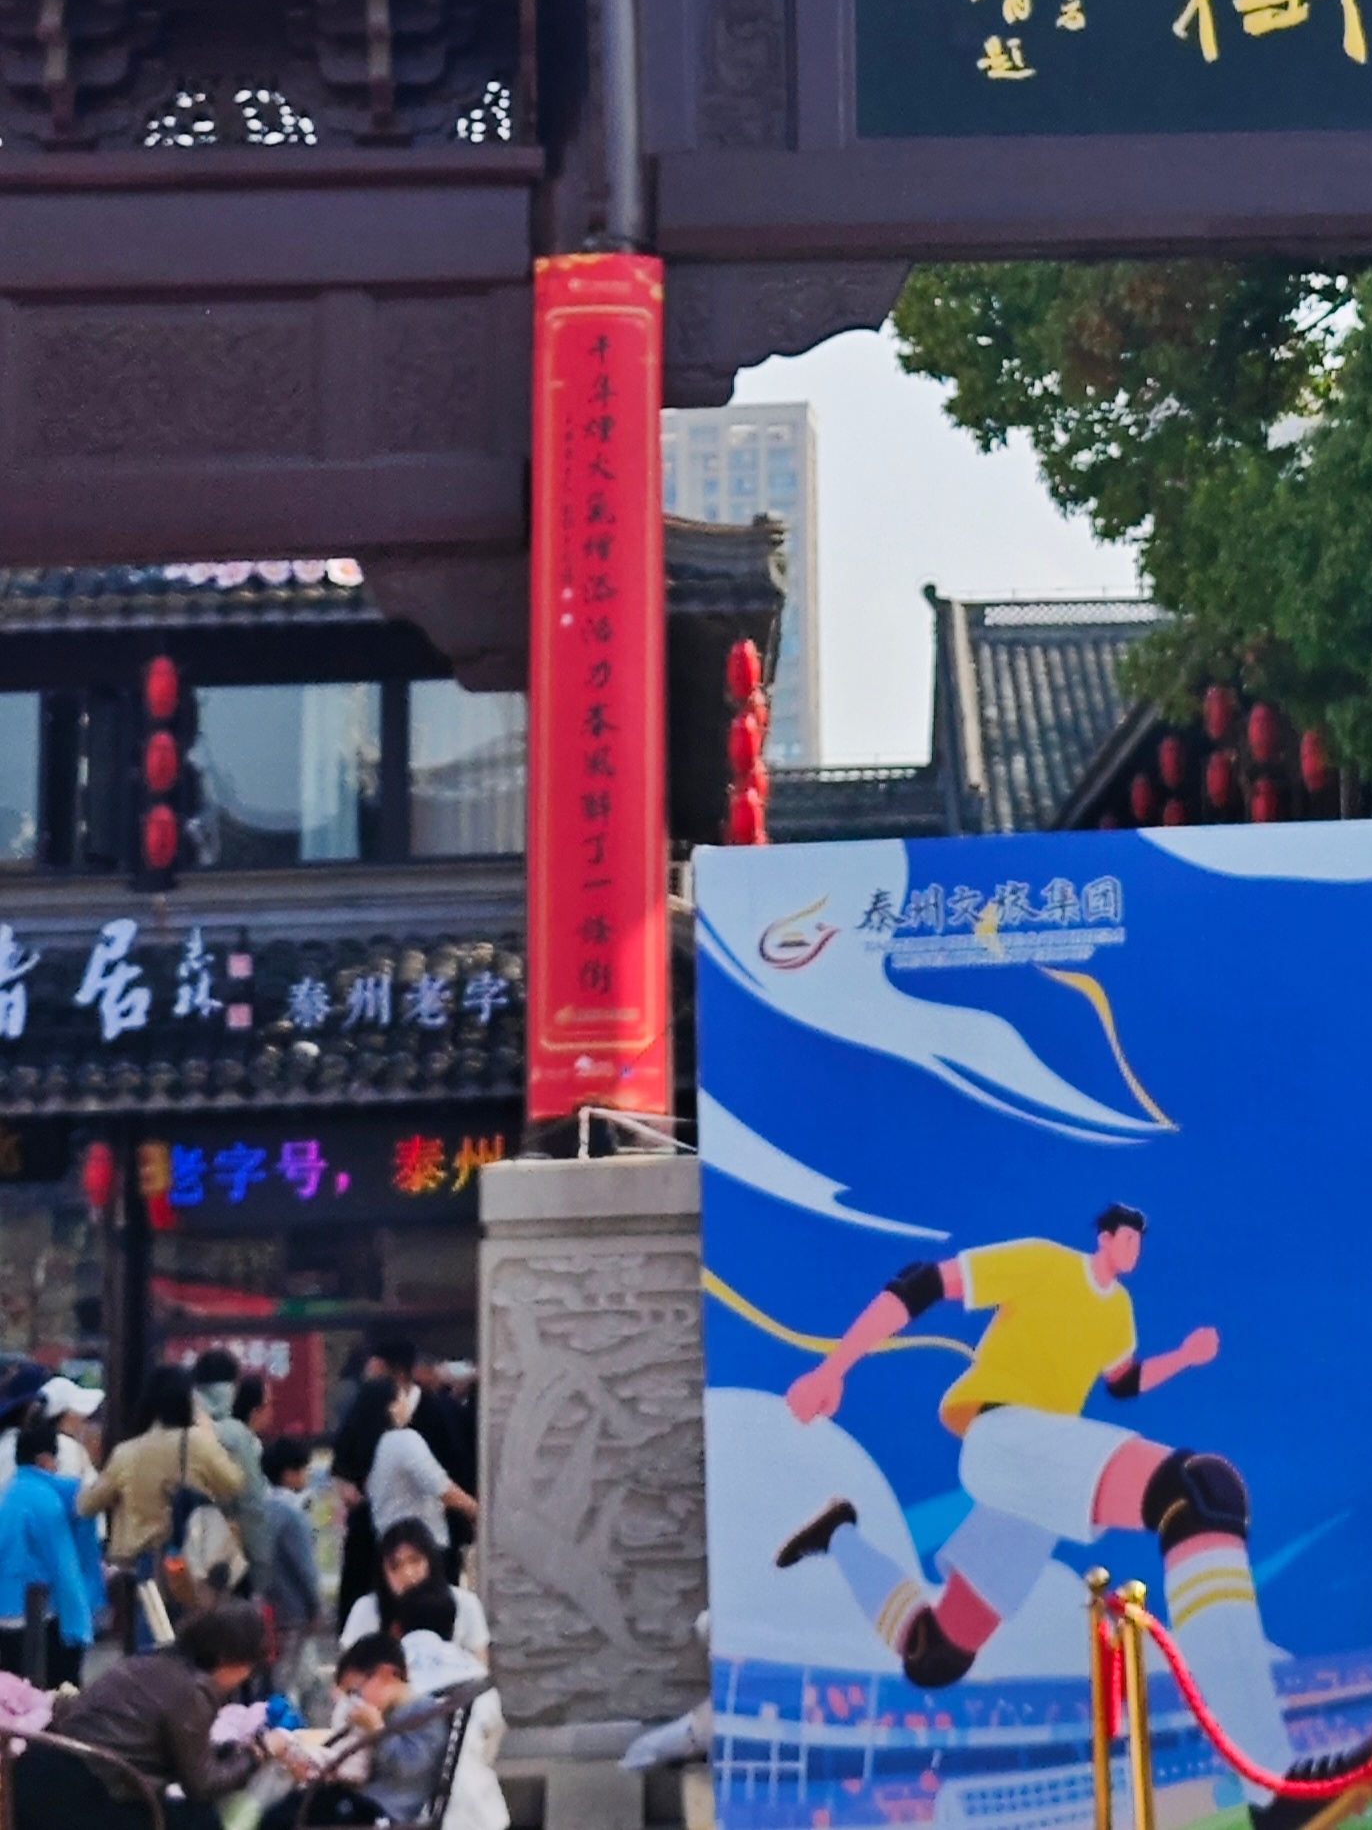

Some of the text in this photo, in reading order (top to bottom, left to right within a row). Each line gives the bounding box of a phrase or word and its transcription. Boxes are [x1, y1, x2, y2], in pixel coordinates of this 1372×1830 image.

[855, 876, 1123, 936] 泰州文旅集团
